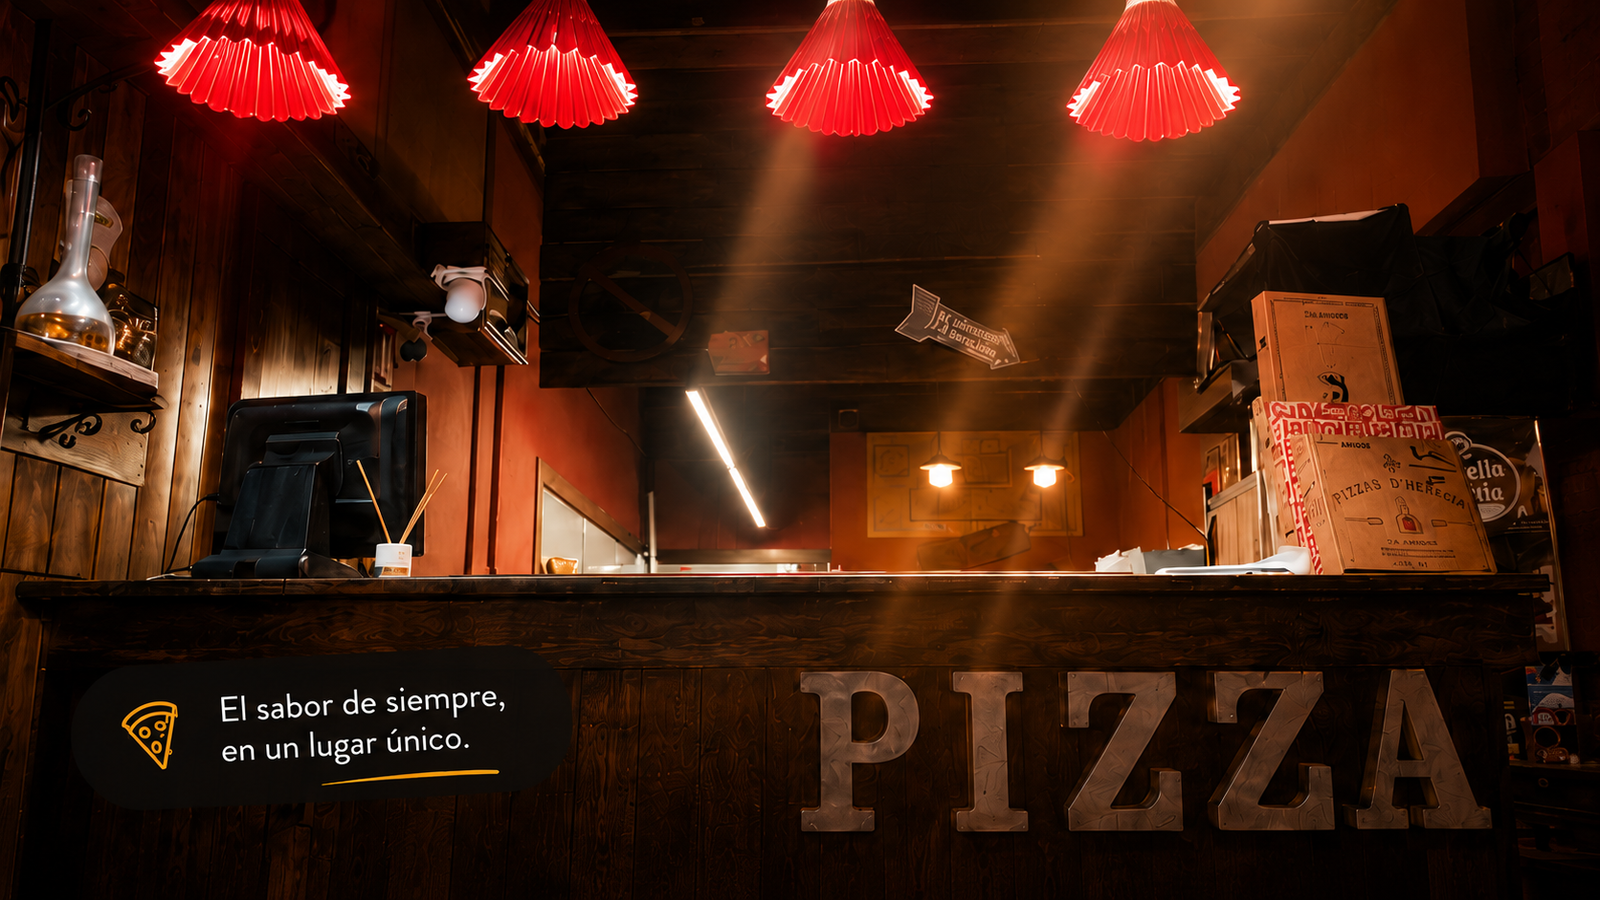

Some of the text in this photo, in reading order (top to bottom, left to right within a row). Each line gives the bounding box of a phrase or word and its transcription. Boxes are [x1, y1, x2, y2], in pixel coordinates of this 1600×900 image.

[1464, 458, 1506, 480] ella
[1332, 478, 1382, 504] PIZZAS
[799, 669, 1493, 833] PIZZA
